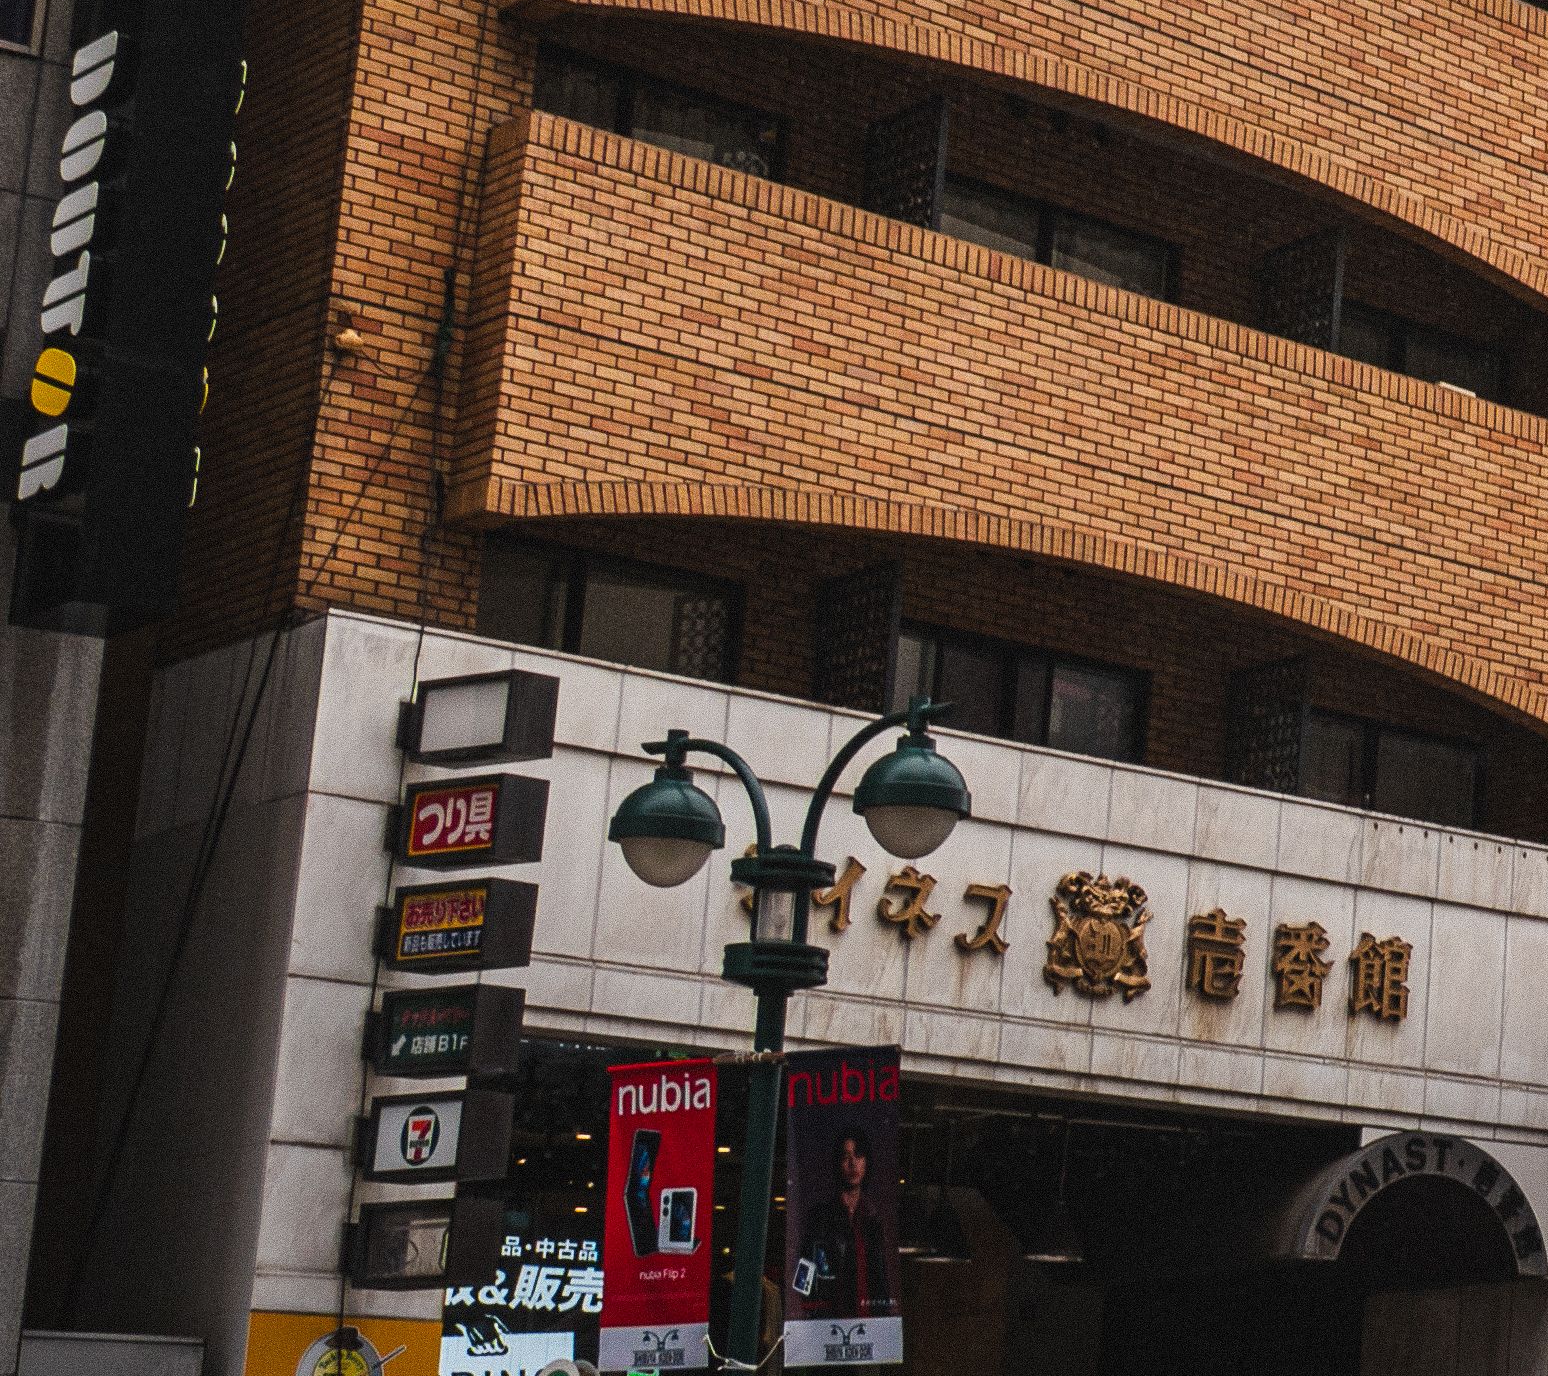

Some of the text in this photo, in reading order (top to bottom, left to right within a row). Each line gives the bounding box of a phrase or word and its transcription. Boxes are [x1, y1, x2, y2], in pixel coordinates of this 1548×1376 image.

[416, 791, 494, 846] つり具
[405, 892, 484, 930] お売り下さい
[1187, 907, 1414, 1024] 壱番館
[617, 1073, 713, 1116] nubia
[788, 1059, 900, 1109] nubia
[1315, 1137, 1455, 1246] DYNAST
